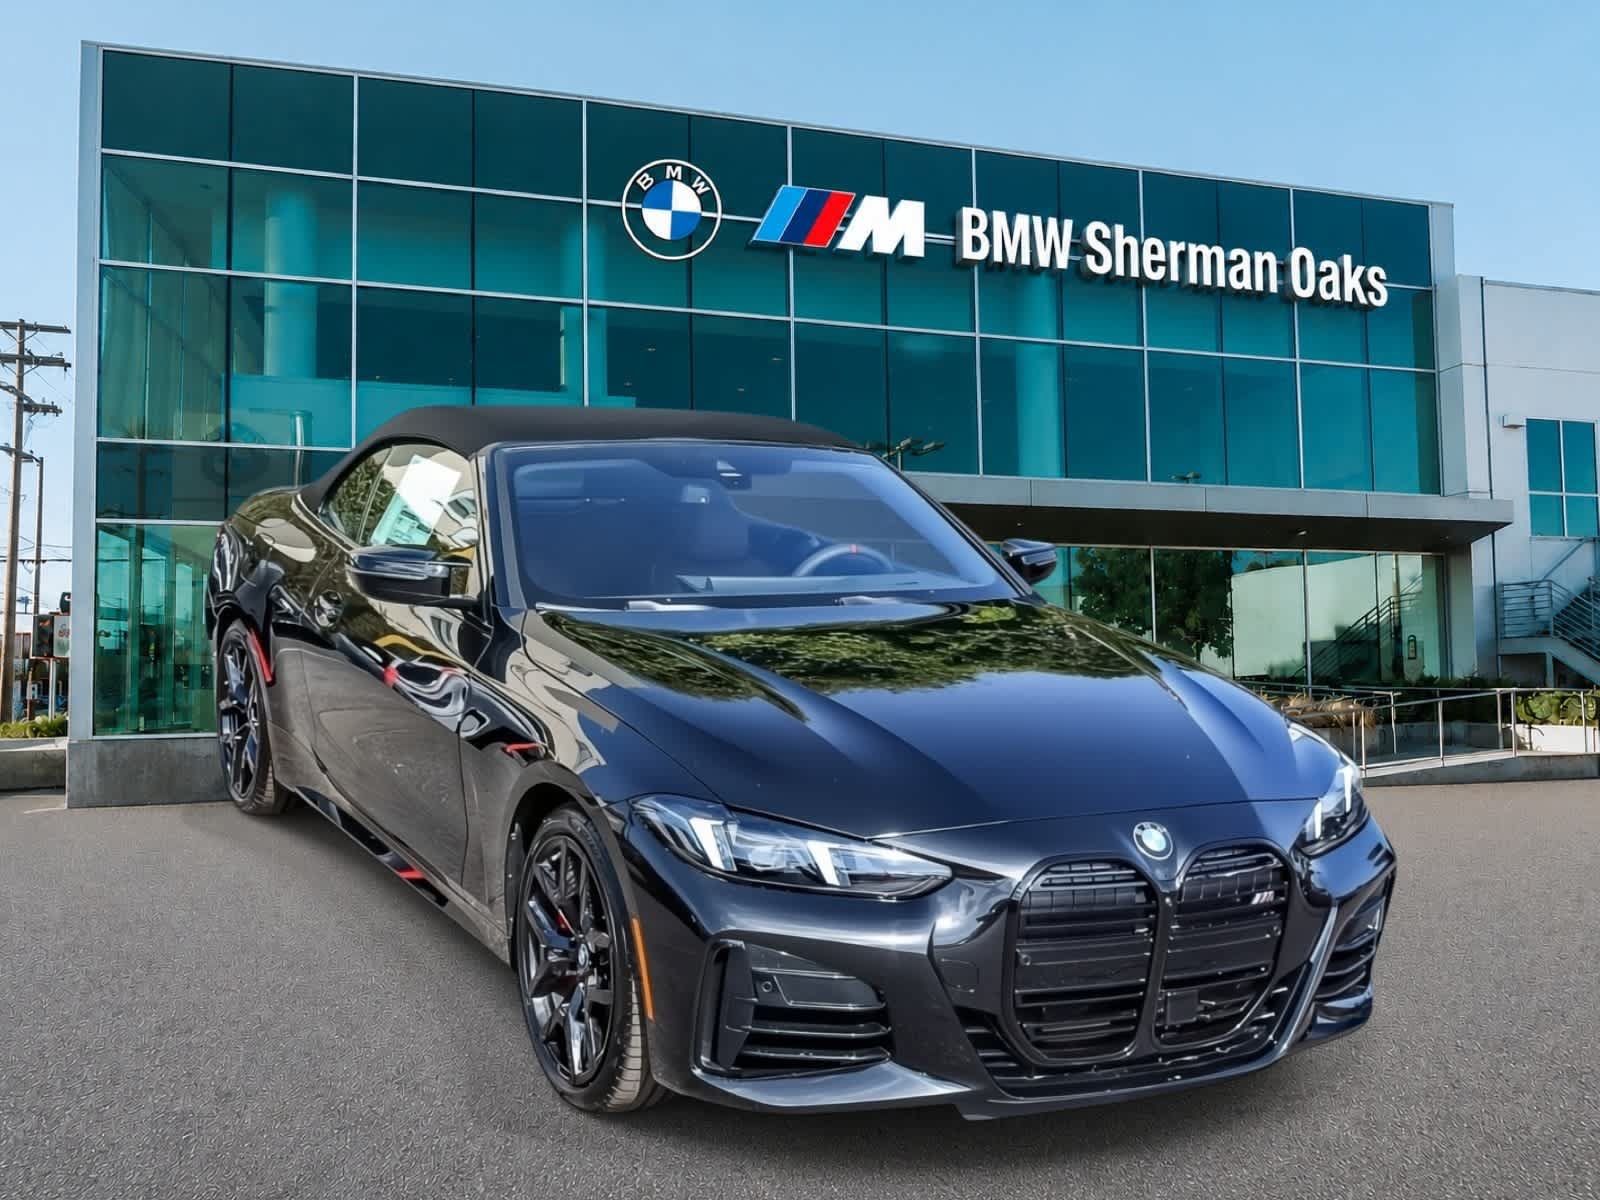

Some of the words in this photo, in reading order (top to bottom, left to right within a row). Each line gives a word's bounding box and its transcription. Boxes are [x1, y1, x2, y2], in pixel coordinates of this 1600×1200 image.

[636, 165, 711, 195] BMW
[836, 194, 925, 258] M
[960, 206, 1074, 271] BMW
[1082, 220, 1279, 294] Sherman
[1289, 246, 1389, 308] Oaks
